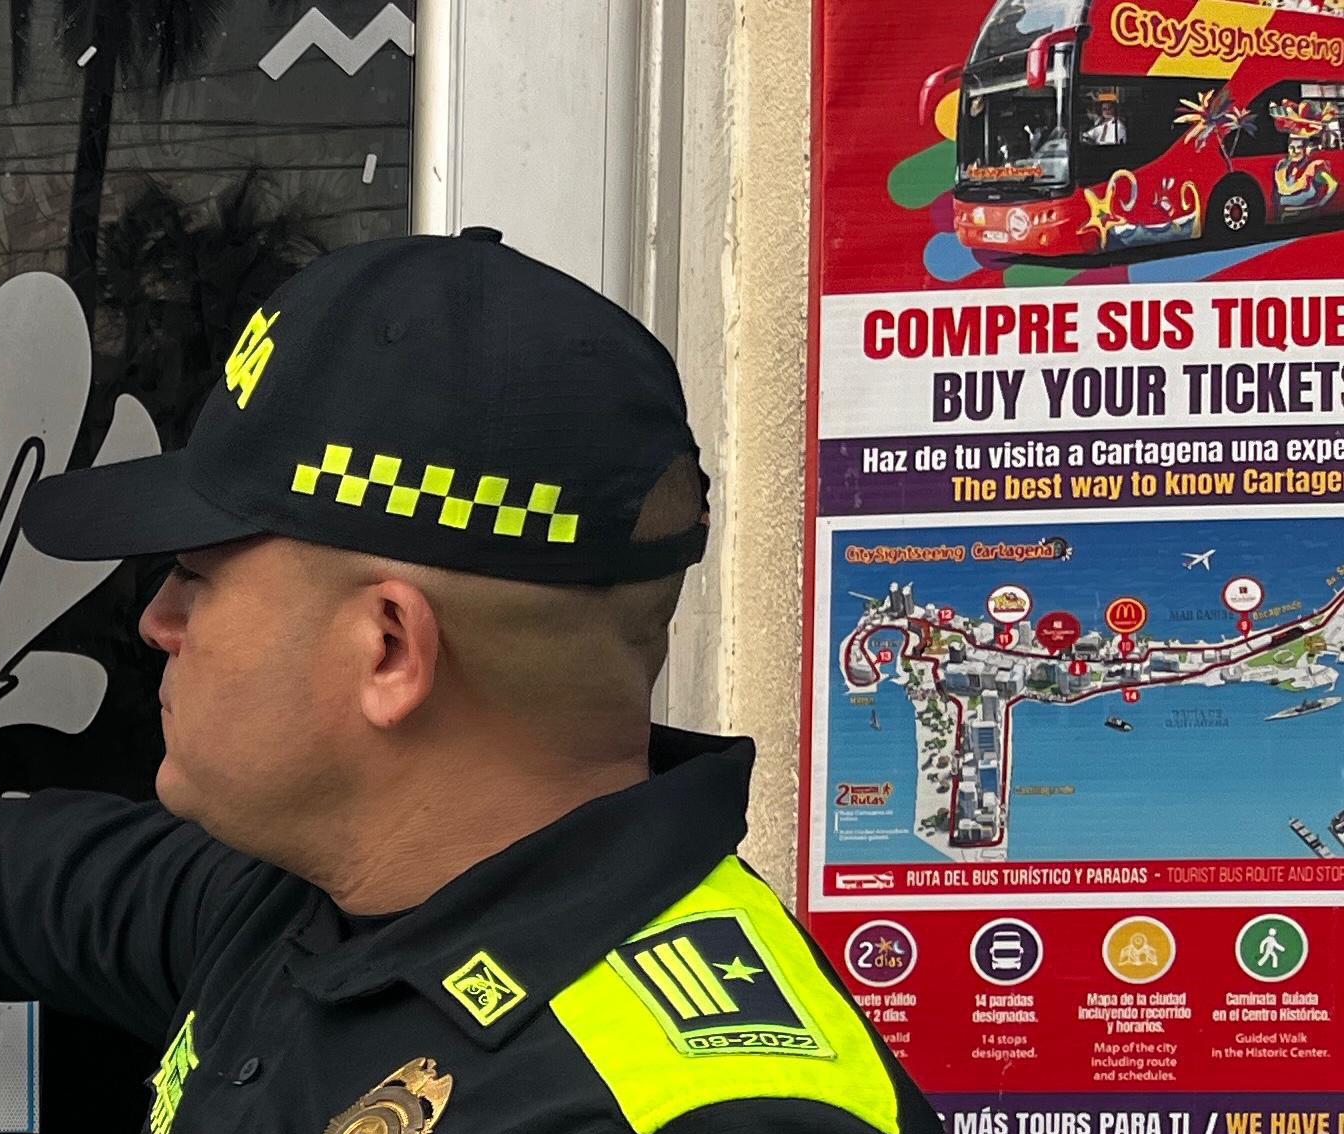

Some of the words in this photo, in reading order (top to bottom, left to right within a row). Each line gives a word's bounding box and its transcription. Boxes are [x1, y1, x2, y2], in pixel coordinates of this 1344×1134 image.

[1111, 2, 1344, 66] CitySightseeing
[864, 302, 1079, 359] COMPRE
[1097, 299, 1193, 351] SUS
[933, 369, 1025, 421] BUY
[1042, 366, 1166, 417] YOUR
[1183, 362, 1344, 415] TICKET
[863, 448, 908, 473] Haz
[915, 445, 946, 470] de
[955, 445, 980, 469] tu
[988, 441, 1060, 468] visita
[1068, 448, 1083, 466] a
[1092, 439, 1223, 469] Cartagena
[1232, 443, 1279, 461] una
[952, 476, 996, 501] The
[1005, 473, 1061, 500] best
[1070, 473, 1123, 500] way
[1131, 472, 1157, 495] to
[1165, 470, 1234, 494] know
[1243, 468, 1344, 495] Cartage
[972, 541, 1054, 561] Cartagena
[907, 870, 940, 886] RUTA
[944, 870, 969, 886] DEL
[973, 869, 999, 886] BUS
[1002, 866, 1070, 885] TURÍSTICO
[1074, 869, 1082, 884] Y
[1086, 867, 1148, 884] PARADAS
[1167, 867, 1215, 883] TOURIST
[1219, 867, 1243, 883] BUS
[1246, 866, 1285, 883] ROUTE
[1288, 866, 1313, 882] AND
[858, 941, 874, 968] 2
[853, 994, 882, 1006] uete
[884, 992, 917, 1006] válido
[975, 995, 986, 1006] 14
[989, 994, 1034, 1008] paradas
[1087, 993, 1117, 1007] Mapa
[1120, 993, 1134, 1005] de
[1136, 993, 1147, 1005] la
[1149, 992, 1187, 1005] ciudad
[1225, 992, 1277, 1006] Caminata
[874, 1011, 881, 1022] 2
[972, 1010, 1038, 1024] designadas.
[1078, 1006, 1138, 1021] incluyendo
[1140, 1007, 1192, 1019] recorrido
[1212, 1010, 1227, 1022] en
[1229, 1008, 1239, 1022] el
[1242, 1008, 1277, 1022] Centro
[982, 1035, 994, 1044] 14
[997, 1034, 1027, 1046] stops
[1235, 1032, 1277, 1044] Guided
[1279, 1032, 1308, 1043] Walk
[971, 1048, 1038, 1060] designated.
[1094, 1043, 1120, 1055] Map
[1122, 1042, 1135, 1053] of
[1136, 1042, 1154, 1053] the
[1156, 1043, 1178, 1055] city
[1211, 1047, 1222, 1058] in
[1224, 1047, 1244, 1058] the
[1246, 1047, 1288, 1058] Historic
[1290, 1047, 1331, 1058] Center.
[1091, 1056, 1144, 1068] including
[1146, 1057, 1178, 1067] route
[1093, 1070, 1115, 1081] and
[1118, 1070, 1177, 1081] schedules.
